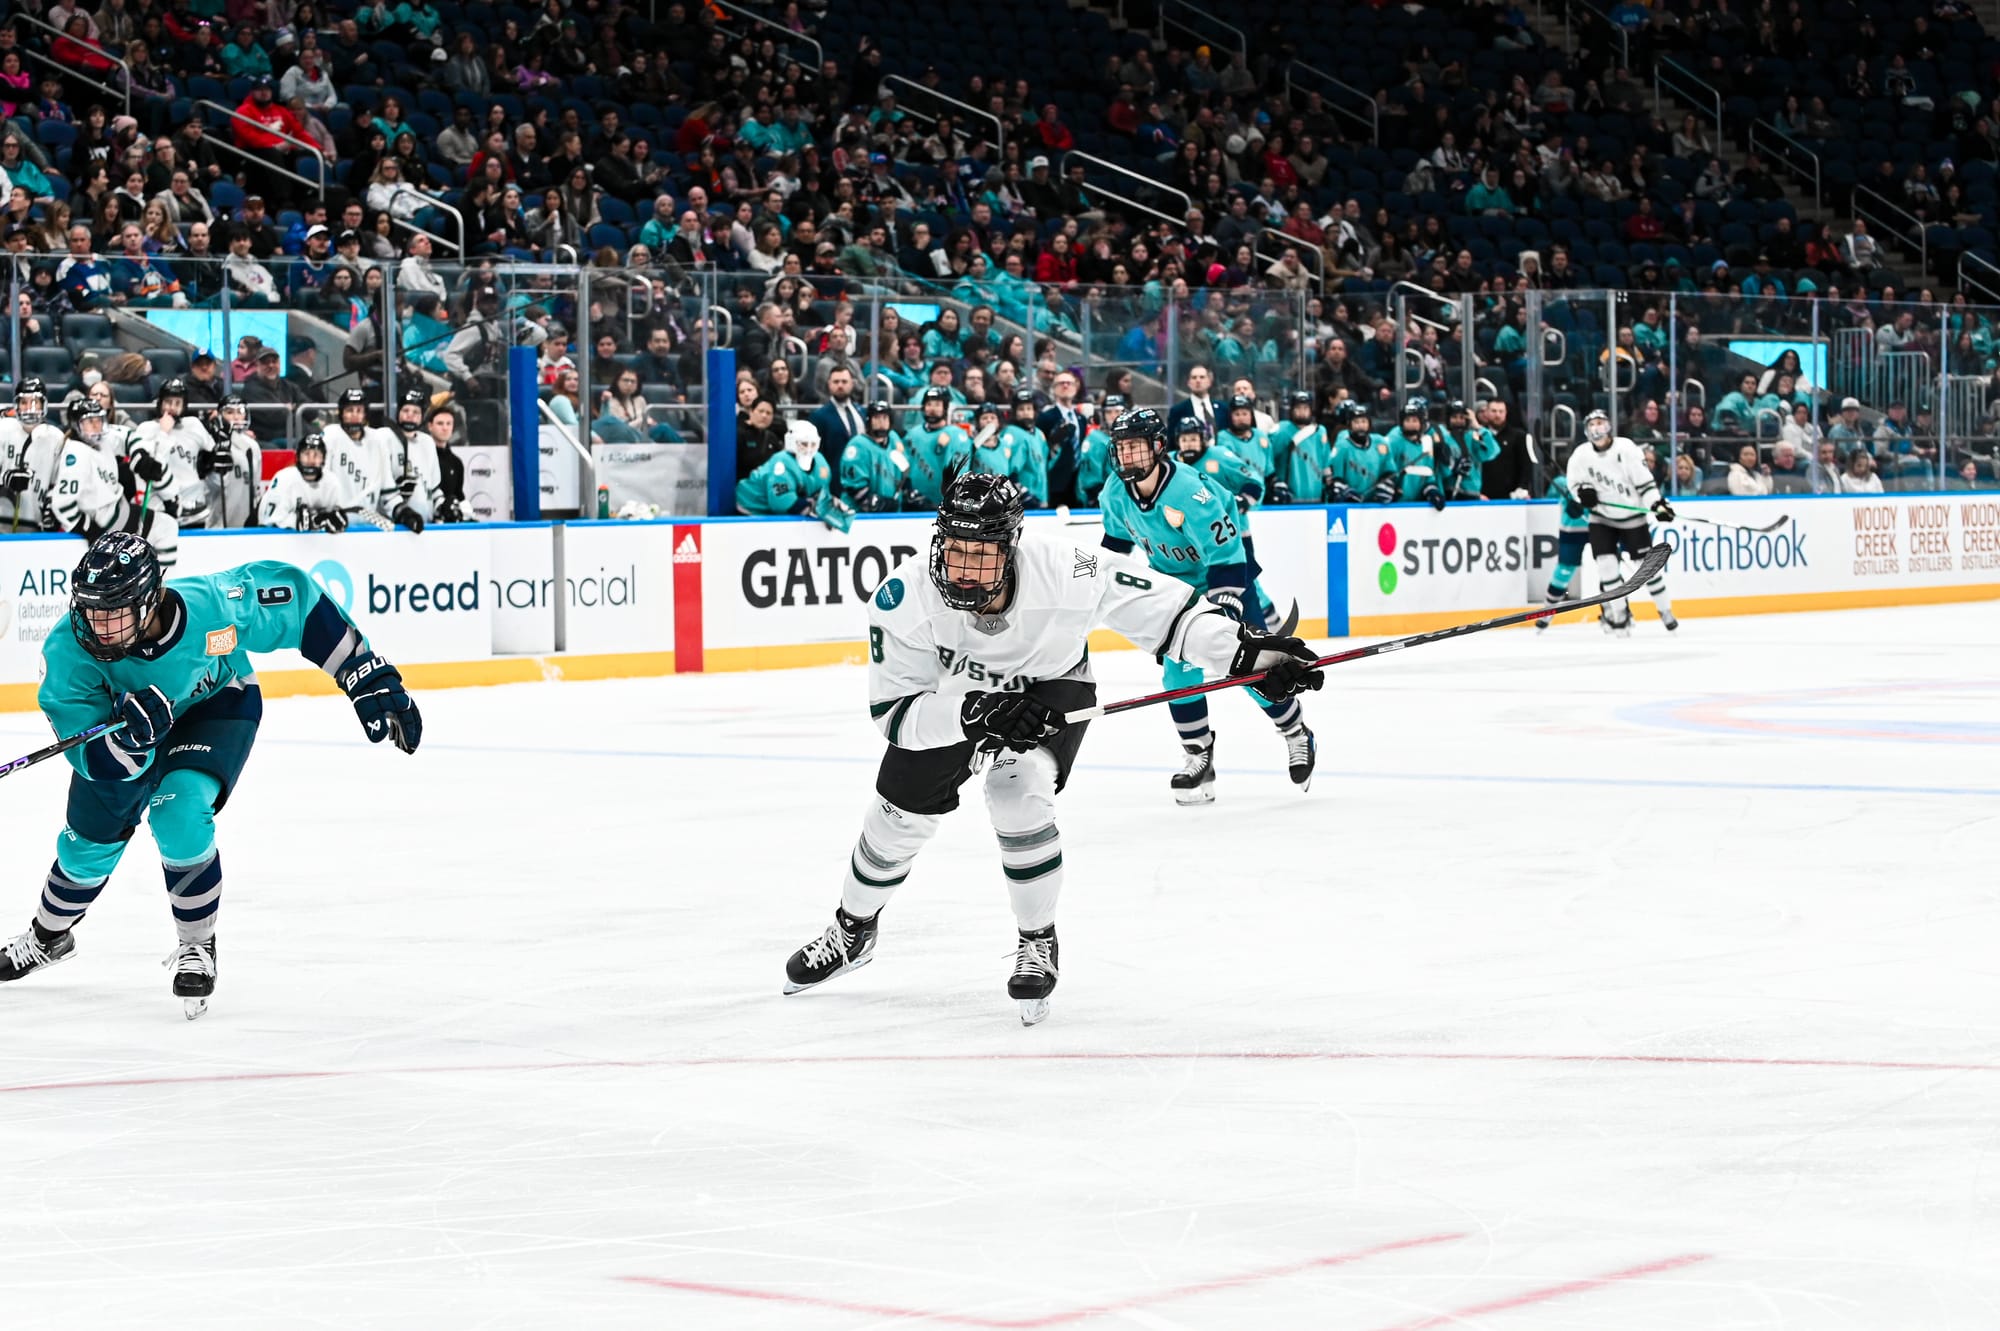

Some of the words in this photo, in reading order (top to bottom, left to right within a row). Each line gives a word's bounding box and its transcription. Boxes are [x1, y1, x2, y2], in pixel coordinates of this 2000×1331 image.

[59, 479, 79, 494] 20
[1588, 467, 1631, 497] BOSTON
[951, 520, 980, 529] CCM
[1853, 505, 1898, 531] WOODY
[1908, 504, 1951, 529] WOODY
[1210, 516, 1237, 546] 25
[1910, 531, 1951, 555] CREEK
[1963, 530, 2000, 553] CREEK
[1664, 519, 1808, 573] PitchBook
[1855, 533, 1897, 557] CREEK
[1853, 558, 1899, 576] DISTILLERS
[1908, 555, 1953, 573] DISTILLERS
[1962, 553, 2000, 570] DISTILLER
[19, 569, 67, 596] AIR
[369, 571, 479, 614] bread
[1115, 571, 1152, 590] 8
[936, 645, 1038, 692] BOSTON
[152, 793, 176, 807] SP
